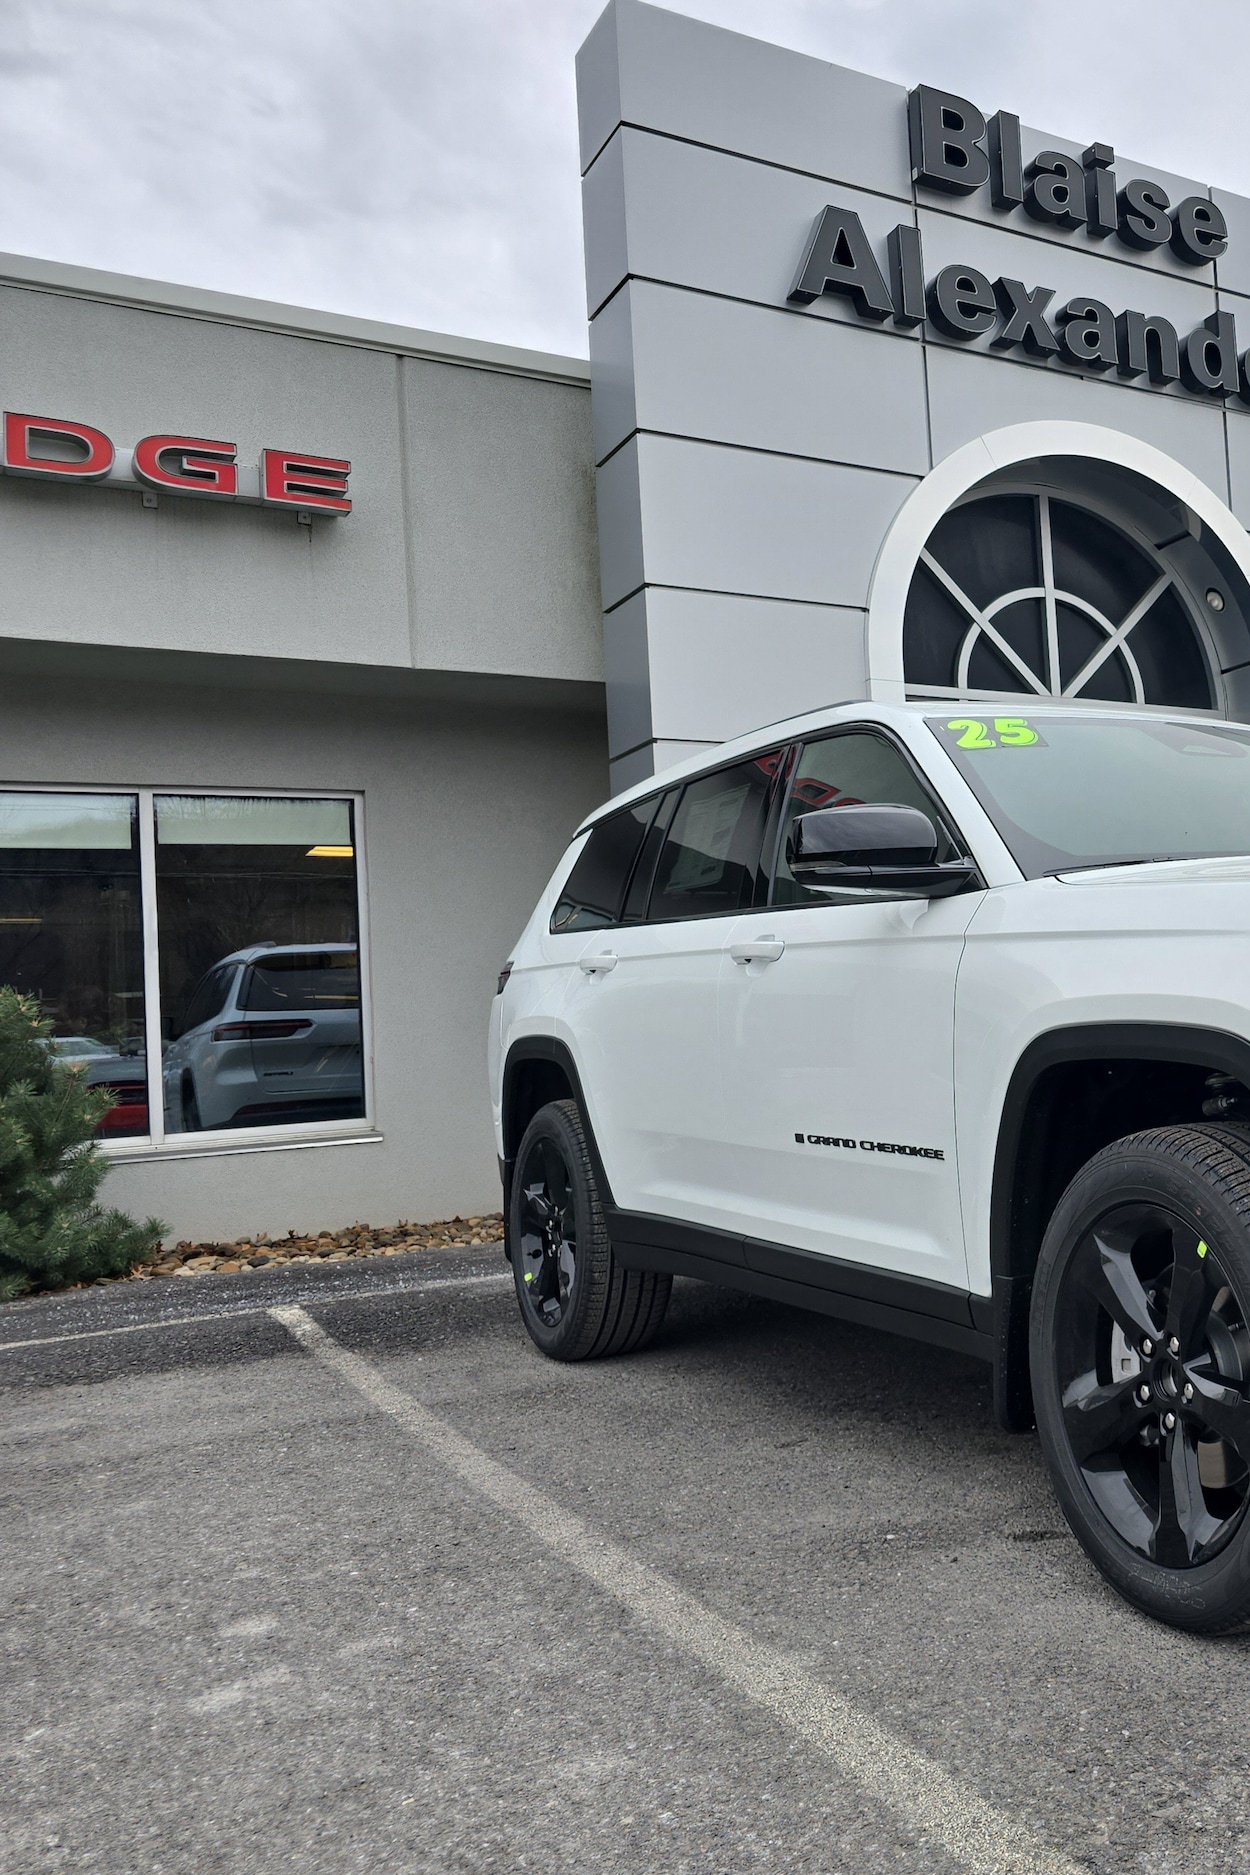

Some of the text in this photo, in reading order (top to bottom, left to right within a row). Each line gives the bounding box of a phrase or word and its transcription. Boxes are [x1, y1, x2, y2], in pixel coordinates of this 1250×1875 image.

[909, 83, 1229, 266] Blaise
[947, 718, 1039, 750] 25
[807, 1134, 945, 1161] GRAND CHEROKEE
